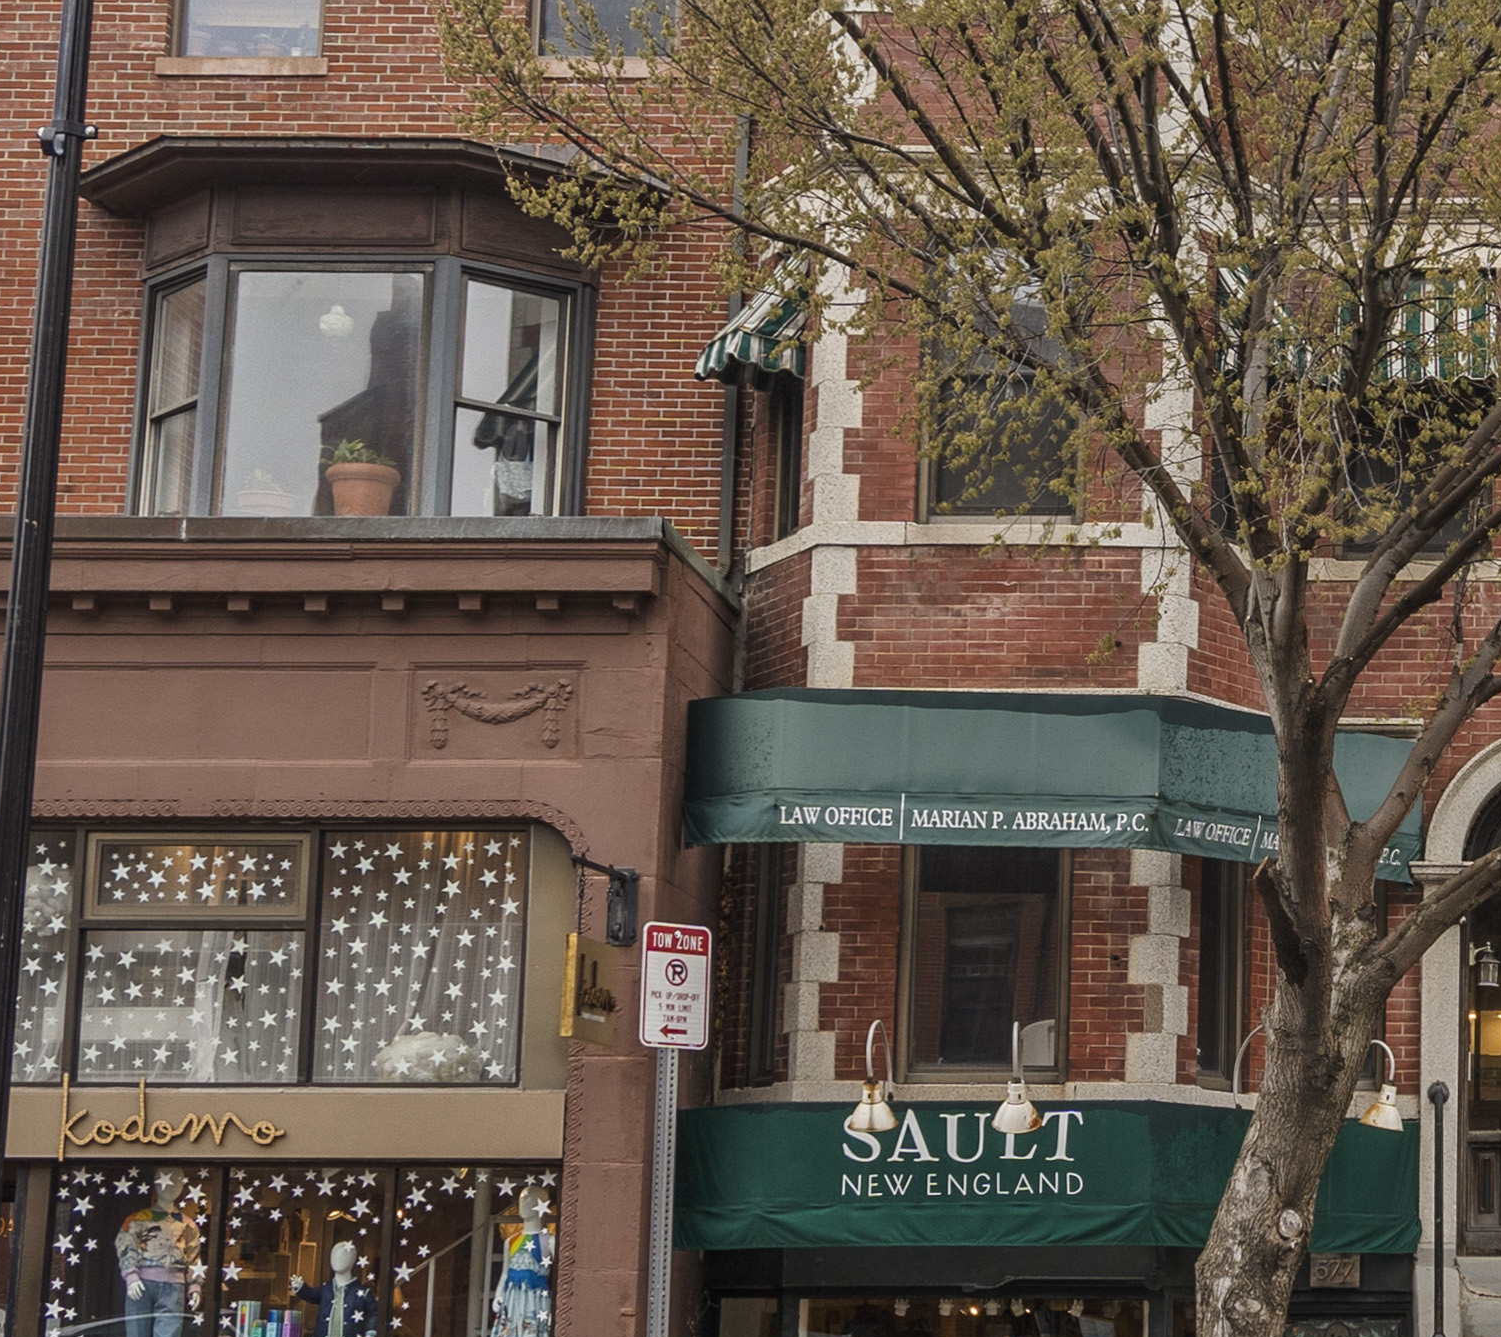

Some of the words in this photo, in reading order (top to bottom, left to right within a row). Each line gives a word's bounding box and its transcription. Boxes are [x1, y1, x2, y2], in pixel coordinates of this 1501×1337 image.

[779, 806, 821, 825] LAW
[825, 807, 893, 827] OFFICE
[910, 809, 988, 830] MARIAN
[991, 811, 1008, 830] P.
[1012, 812, 1111, 834] ABRAHAM,
[1115, 813, 1149, 832] P.C.
[1173, 818, 1206, 838] LAW
[1204, 822, 1252, 846] OFFICE
[652, 931, 673, 949] TOW
[676, 934, 704, 952] ZONE
[651, 990, 662, 999] PICK
[666, 1004, 675, 1012] MIN
[678, 1004, 692, 1013] LIMIT
[58, 1072, 285, 1162] kodomo
[842, 1108, 1084, 1163] SAULT
[841, 1173, 913, 1197] NEW
[926, 1172, 1084, 1197] ENGLAND
[1316, 1259, 1356, 1281] 577
